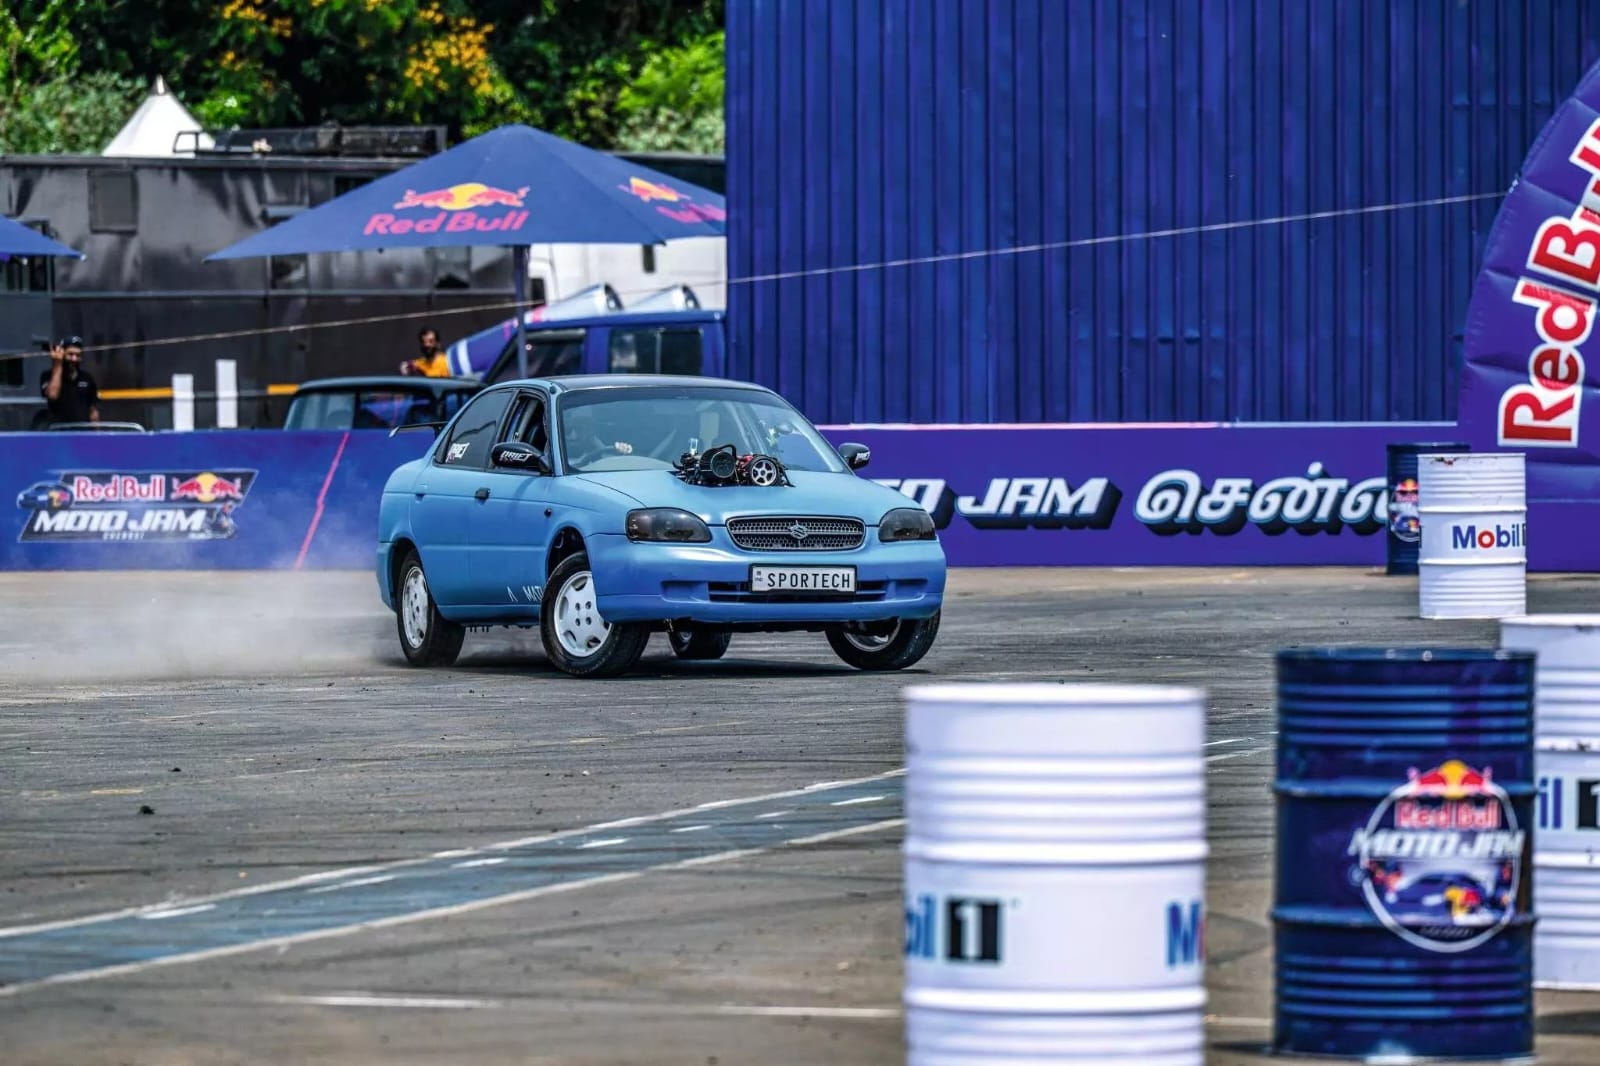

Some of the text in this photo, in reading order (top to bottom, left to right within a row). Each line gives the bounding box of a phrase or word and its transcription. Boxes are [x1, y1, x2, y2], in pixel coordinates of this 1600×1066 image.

[364, 210, 530, 235] Red Bull
[1499, 278, 1598, 446] Red
[73, 474, 166, 503] Red Bull
[955, 477, 1110, 517] JAM
[33, 508, 208, 532] MOTO JAM
[1452, 523, 1520, 549] Mobil
[767, 572, 850, 589] SPORTECH
[1395, 800, 1502, 829] Red Bull
[1348, 829, 1461, 857] MOTO
